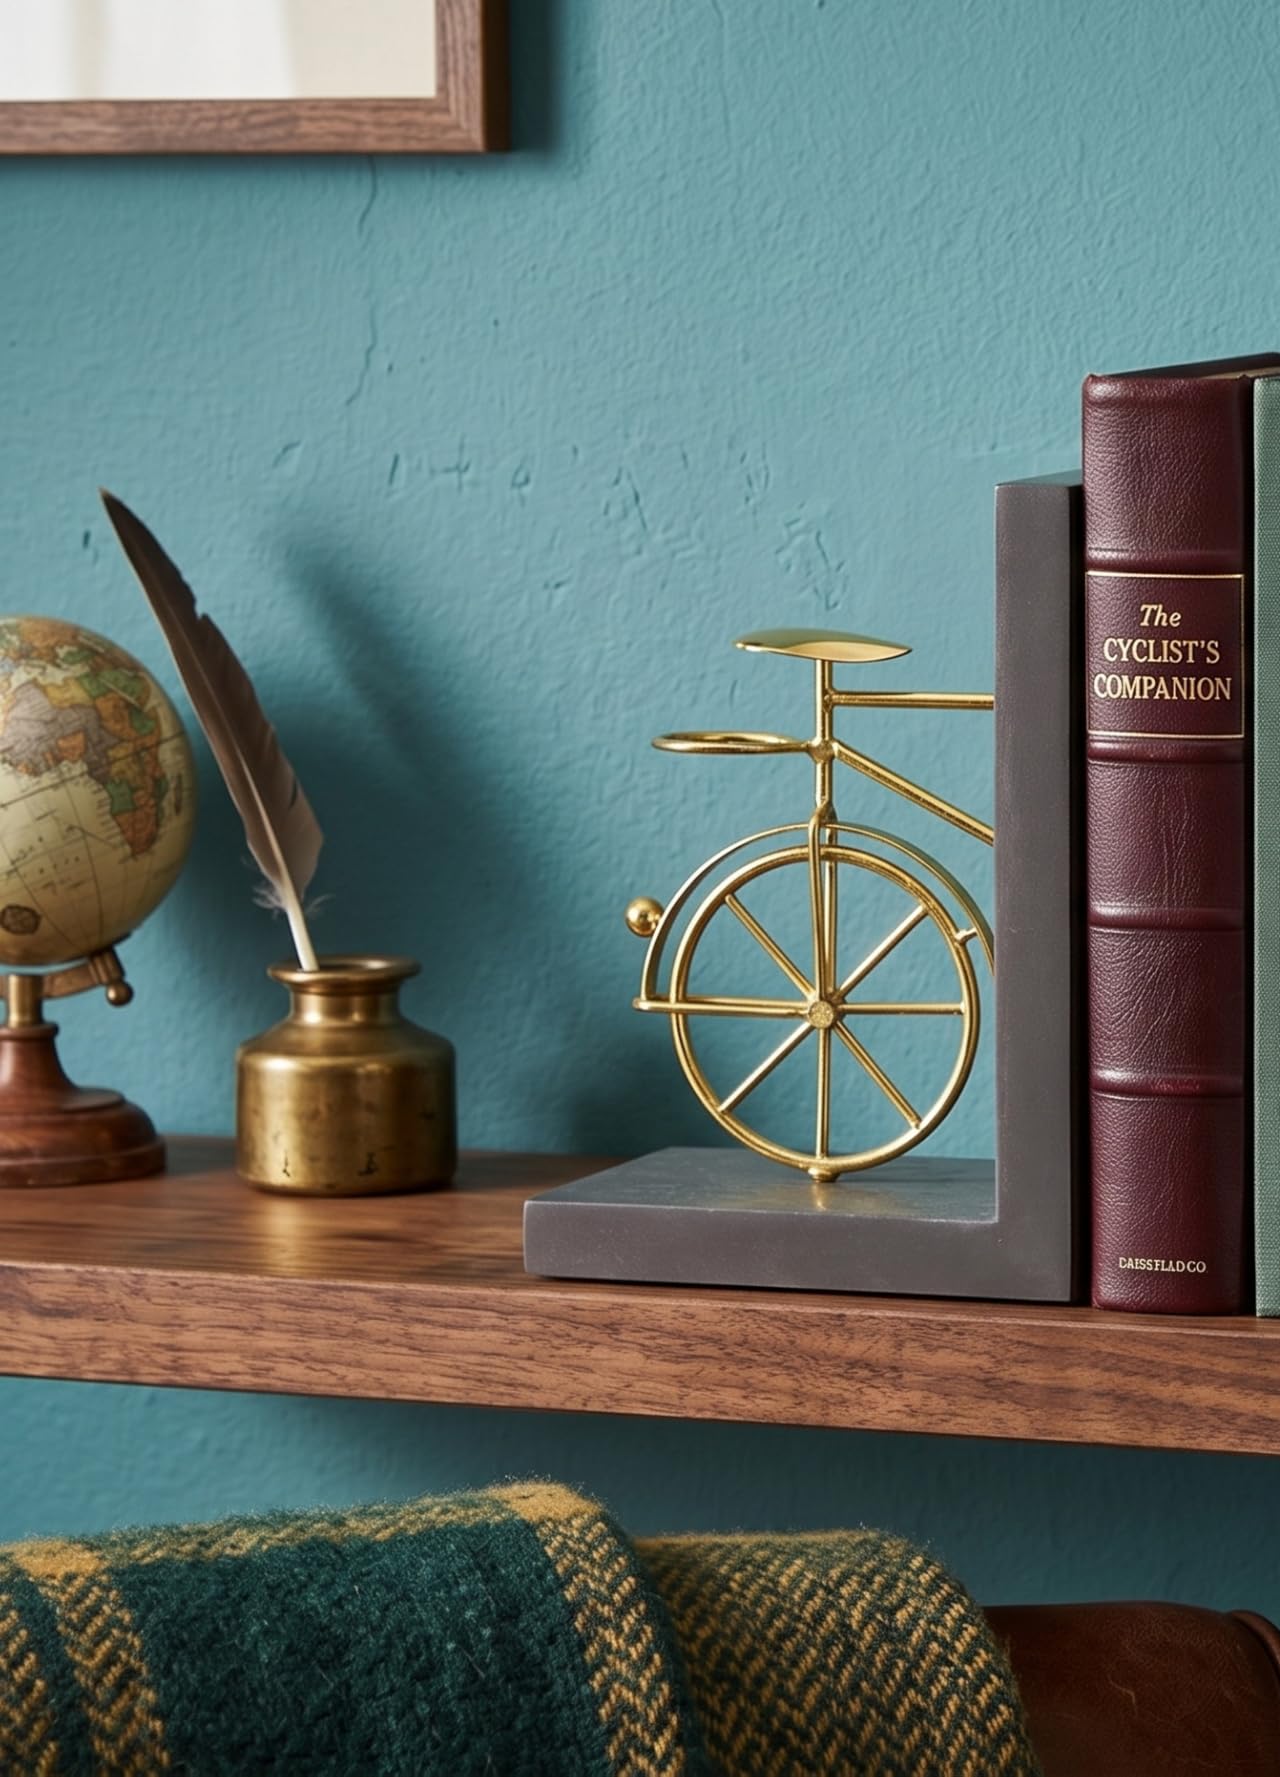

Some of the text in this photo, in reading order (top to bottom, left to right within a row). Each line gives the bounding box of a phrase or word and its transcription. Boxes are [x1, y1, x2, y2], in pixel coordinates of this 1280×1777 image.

[1139, 603, 1183, 628] The
[1102, 637, 1221, 665] CYCLIST'S
[1093, 673, 1233, 701] COMPANION
